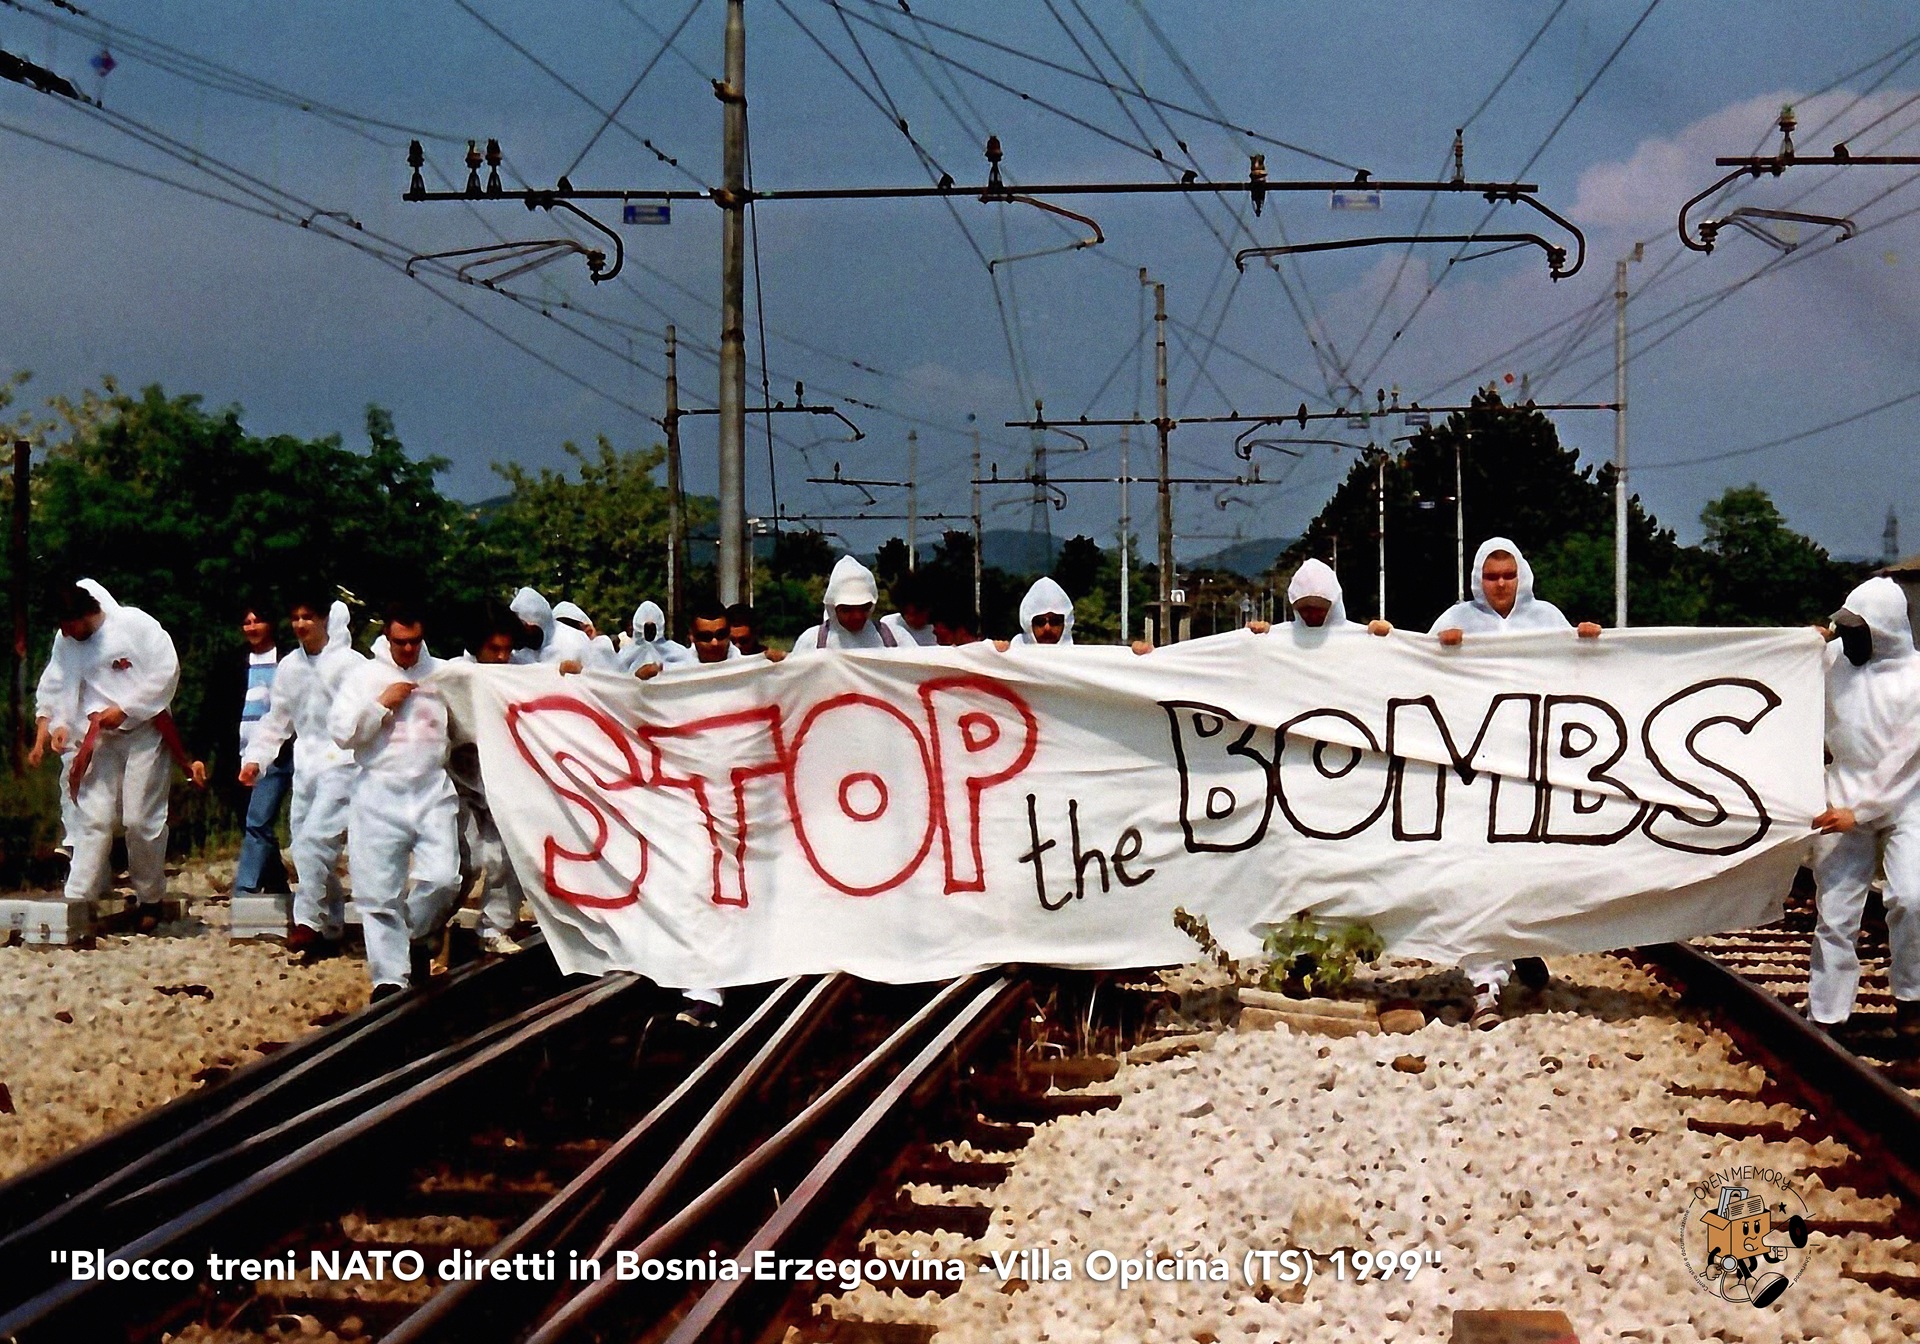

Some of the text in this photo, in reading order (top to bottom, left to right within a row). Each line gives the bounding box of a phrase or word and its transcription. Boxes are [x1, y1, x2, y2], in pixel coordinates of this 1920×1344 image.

[507, 676, 1781, 910] STOP the BOMBS
